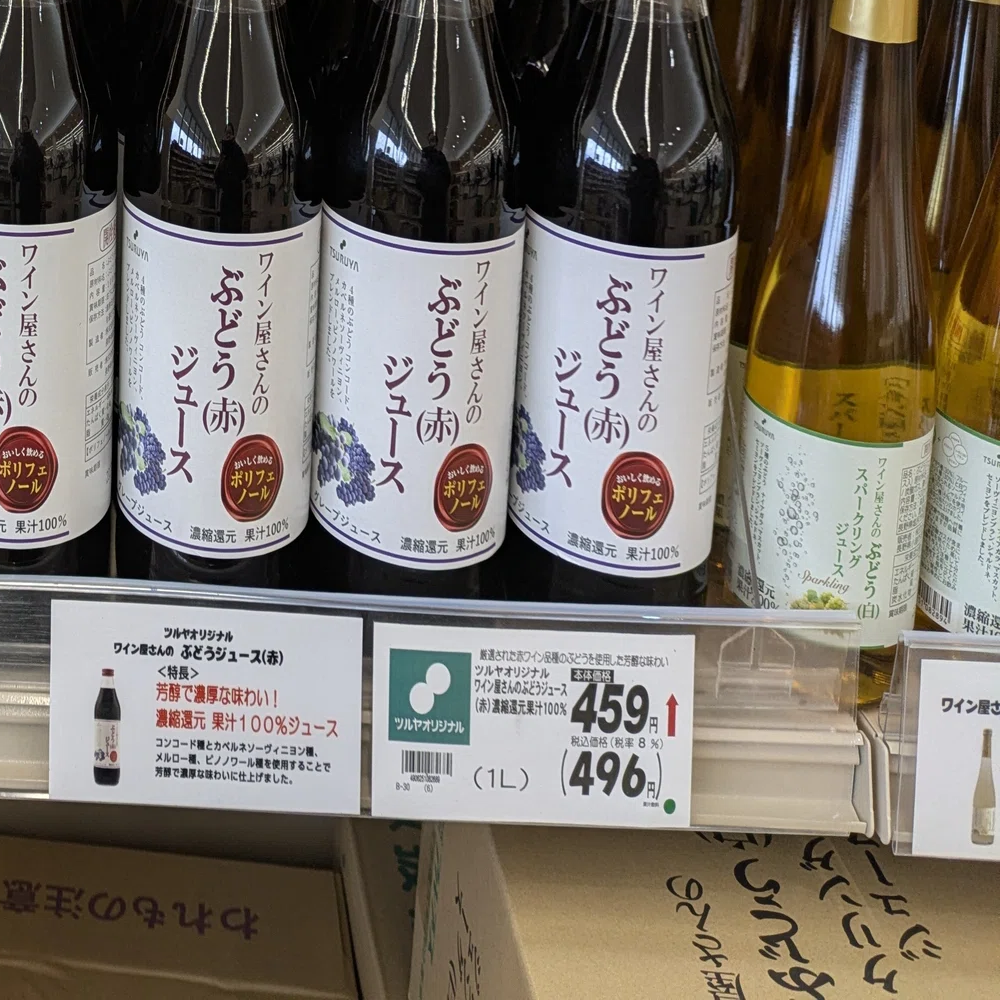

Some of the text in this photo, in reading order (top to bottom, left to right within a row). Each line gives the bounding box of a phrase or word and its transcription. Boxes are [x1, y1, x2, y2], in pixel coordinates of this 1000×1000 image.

[18, 243, 39, 408] ワイン屋さんの
[250, 251, 274, 415] ワイン屋さんの
[465, 260, 491, 425] ワイン屋さんの
[637, 267, 668, 434] ワイン屋さんの
[166, 344, 200, 484] ジュース
[546, 346, 582, 488] ジュース
[375, 355, 413, 495] ジュース
[0, 460, 48, 478] ポリフェ
[230, 468, 276, 488] ポリフェ
[6, 477, 43, 495] ノール
[236, 485, 271, 505] ノール
[443, 478, 486, 497] ポリフェ
[611, 484, 664, 505] ポリフェ
[449, 495, 481, 515] ノール
[618, 502, 657, 523] ノール
[14, 513, 67, 534] 果汁100%
[849, 467, 869, 569] スパークリング
[244, 518, 289, 543] 果汁100%
[455, 526, 496, 553] 果汁100%
[625, 543, 680, 564] 果汁100%
[831, 522, 850, 578] ジュース
[797, 568, 851, 594] Sparkling
[163, 627, 233, 643] ツルヤオリジナル
[113, 642, 284, 666] ワイン屋さんの ぶどうジュース(赤)
[474, 664, 549, 679] ツルヤオリジナル
[573, 669, 611, 682] 本体価格
[474, 679, 568, 697] ワイン屋さんのぶどうジュース
[155, 708, 206, 731] 濃縮還元
[394, 716, 465, 734] ツルヤオリジナル
[154, 766, 293, 785] 芳醇で濃厚な味わいに仕上げました。
[2, 878, 260, 940] われもの注意
